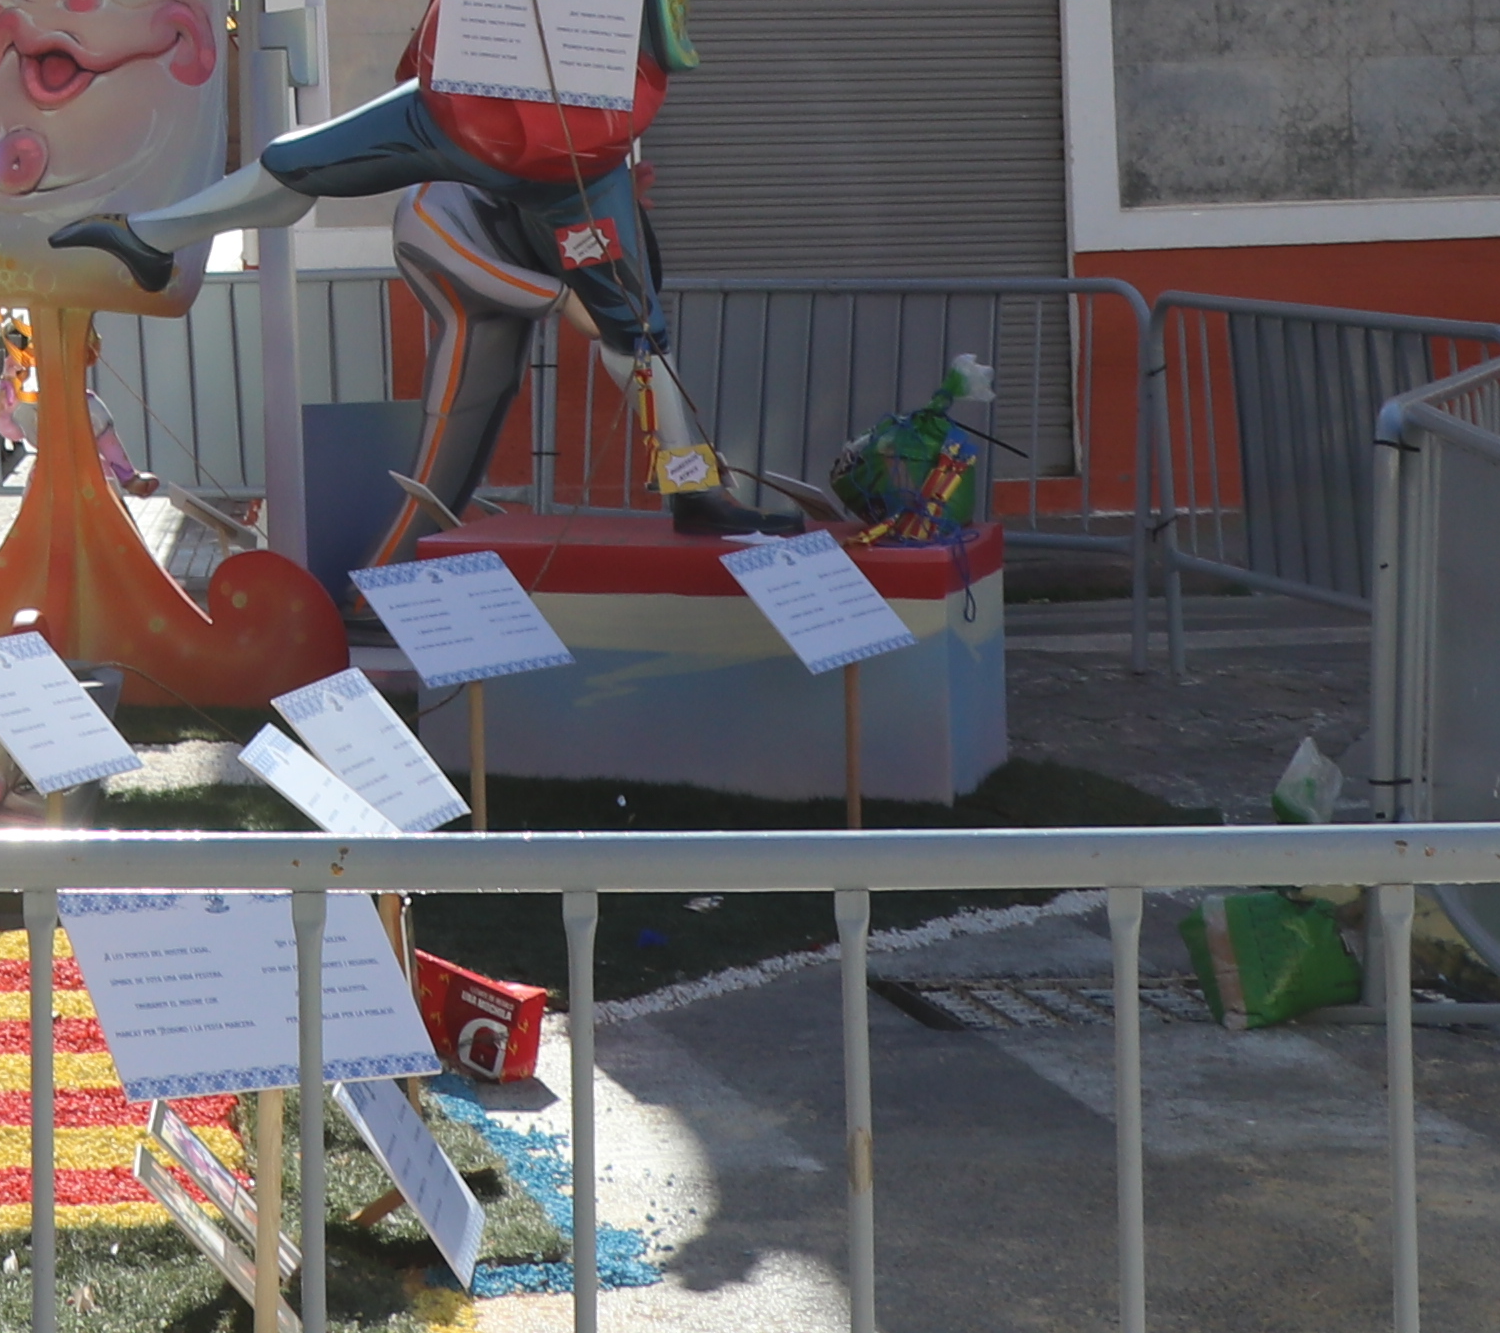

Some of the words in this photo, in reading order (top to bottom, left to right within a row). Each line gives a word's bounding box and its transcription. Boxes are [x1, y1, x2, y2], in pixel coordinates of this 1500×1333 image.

[112, 951, 124, 961] LES
[125, 950, 150, 960] PORTES
[151, 948, 163, 958] DEL
[164, 947, 188, 957] NOSTRE
[135, 976, 145, 986] DE
[164, 973, 177, 983] UNA
[178, 972, 193, 982] VIDA
[170, 999, 178, 1009] EL
[179, 998, 203, 1008] NOSTRE
[461, 989, 478, 1007] UNA
[477, 997, 513, 1022] MOCHILA
[144, 1027, 156, 1037] PER
[194, 1023, 203, 1033] LA
